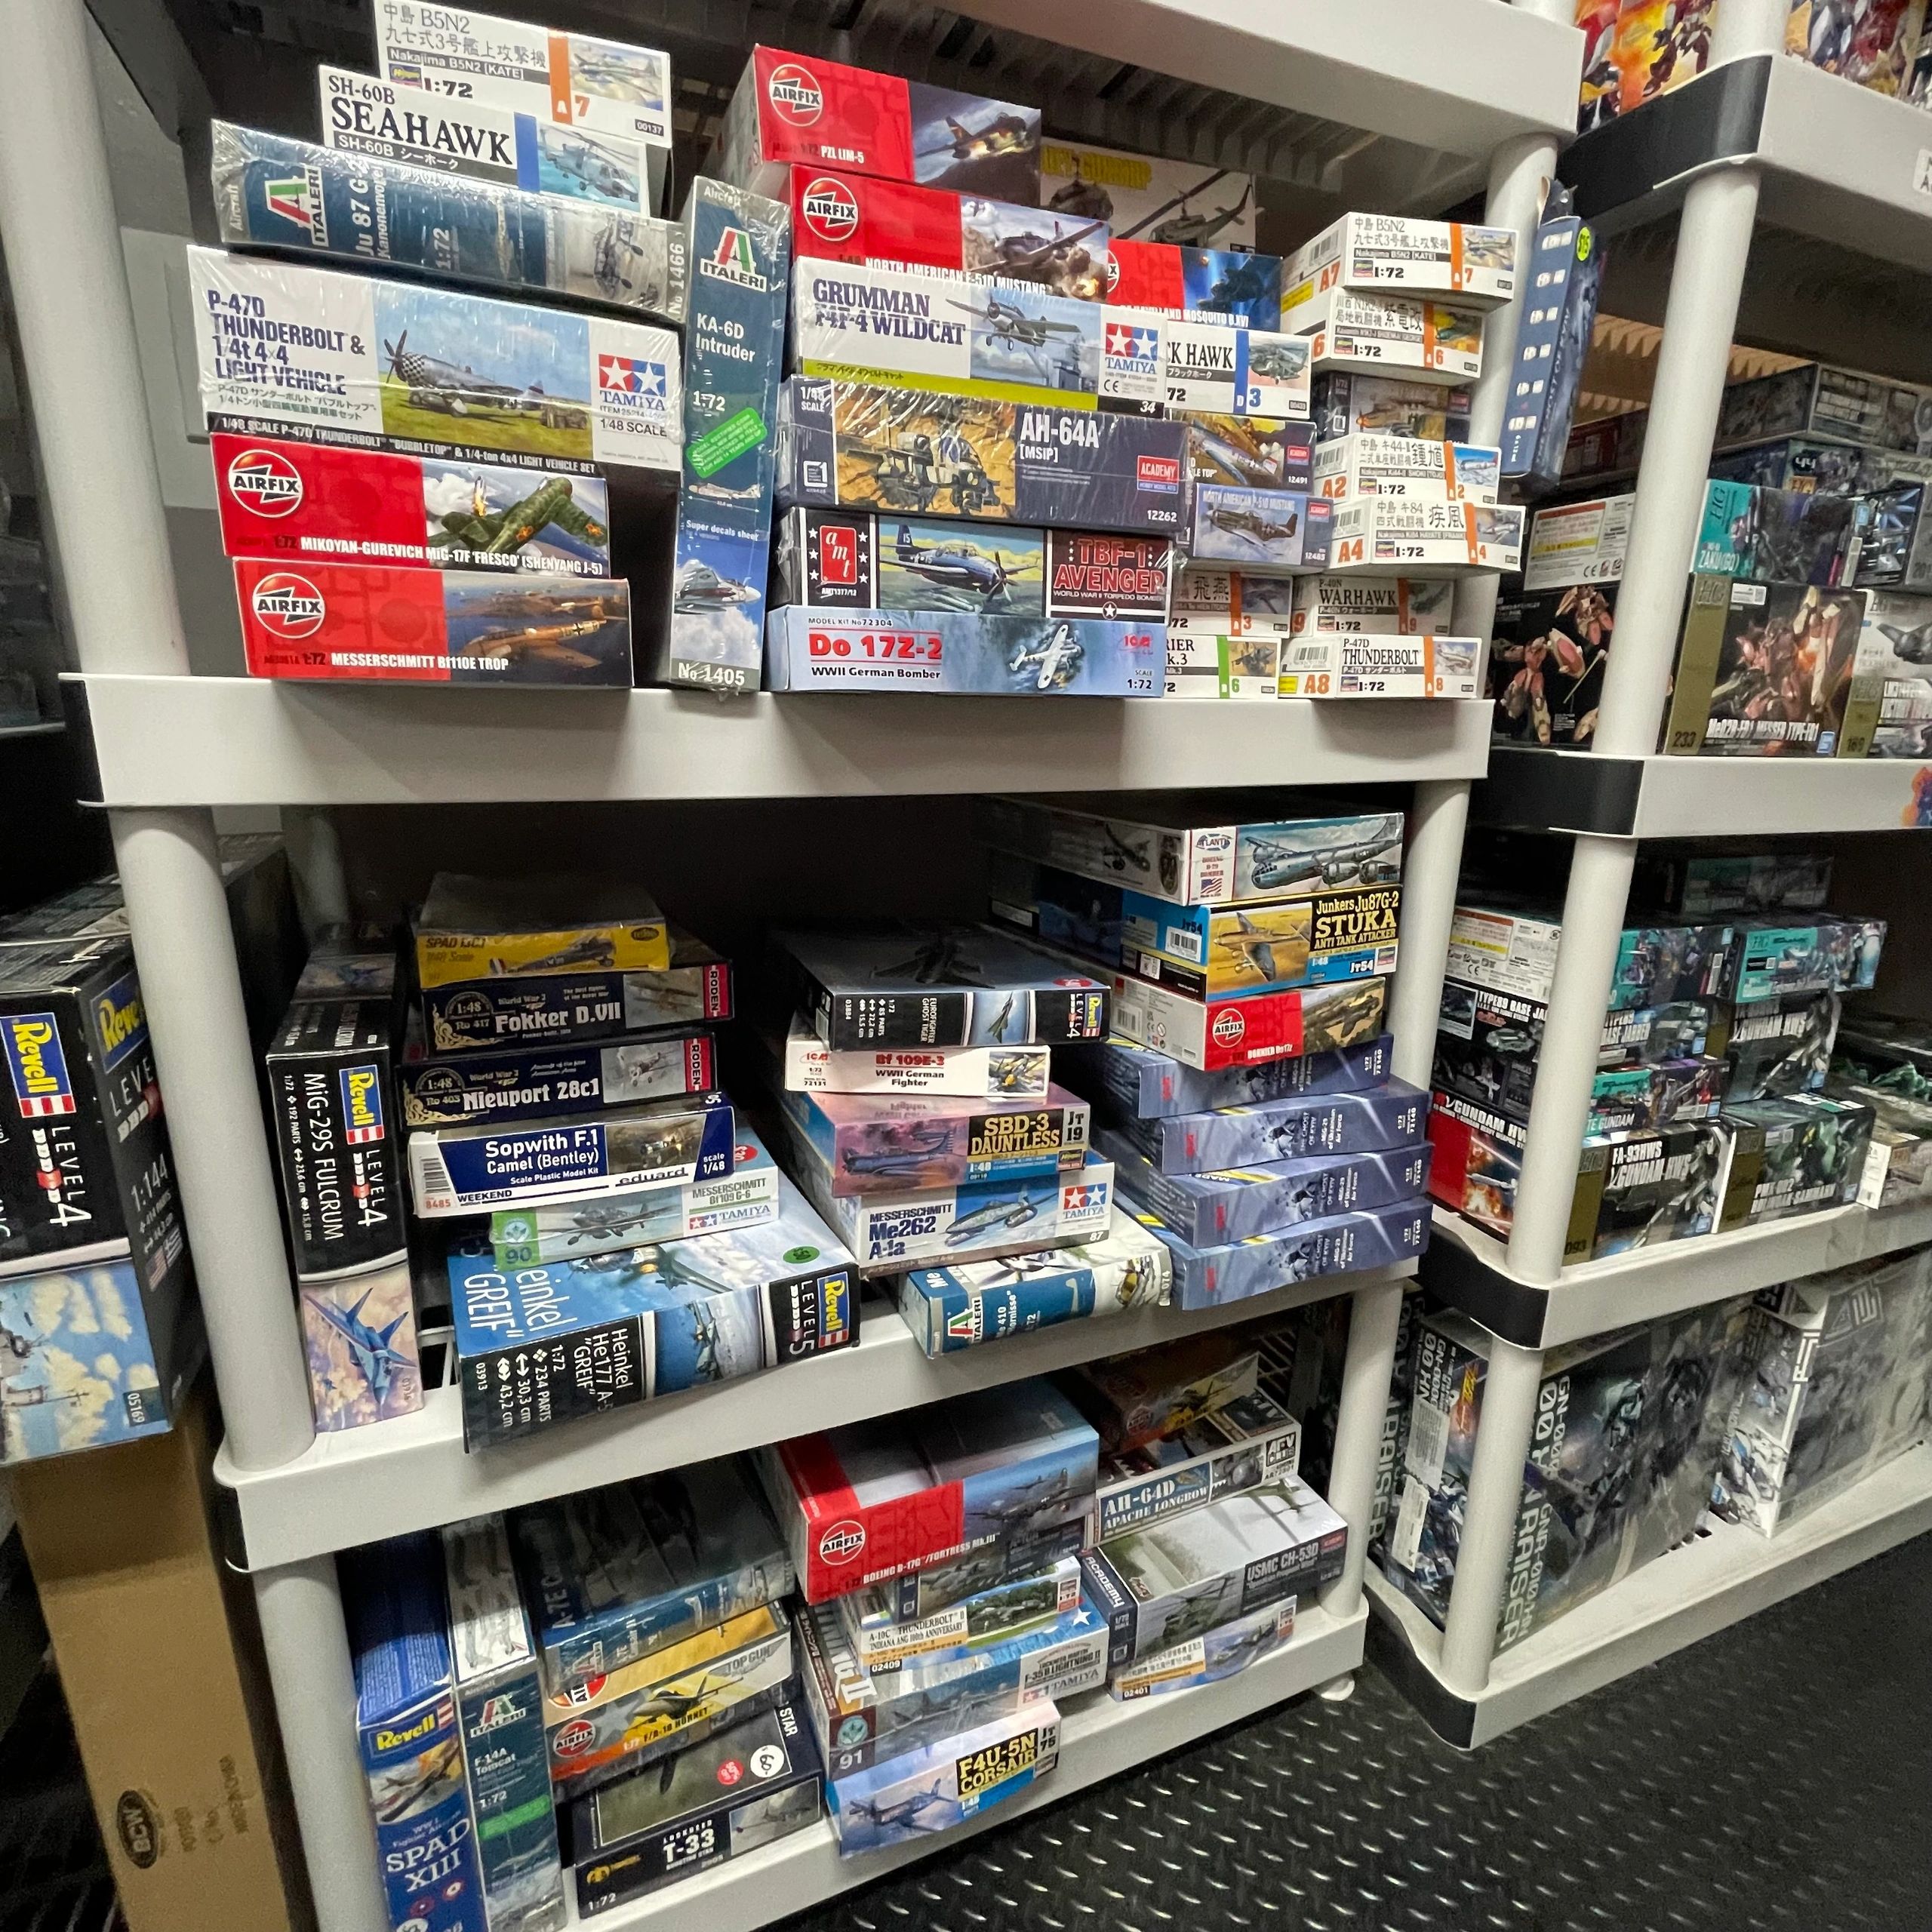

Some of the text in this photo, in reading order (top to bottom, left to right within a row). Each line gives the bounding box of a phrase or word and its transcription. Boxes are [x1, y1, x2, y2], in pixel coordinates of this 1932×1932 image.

[422, 8, 469, 33] B5N2
[390, 48, 525, 80] Nakajima B5N2 [KATE]
[329, 76, 395, 105] SH-60B
[773, 86, 820, 105] AIRFIX
[331, 97, 512, 165] SEAHAWK
[339, 135, 458, 171] SH-60B シーホーク
[821, 146, 864, 164] PZL LIM-5
[806, 204, 857, 219] AIRFIX
[1377, 218, 1404, 232] B5N2
[703, 262, 764, 290] ITALERI
[1374, 267, 1404, 278] 1:72
[1465, 268, 1473, 283] 7
[813, 278, 930, 317] GRUMMAN
[211, 313, 365, 355] THUNDERBOLT &
[697, 312, 743, 340] KA-6D
[696, 334, 755, 363] Intruder
[1186, 343, 1233, 369] HAWK
[1435, 349, 1443, 365] 6
[1106, 358, 1156, 375] TAMIYA
[600, 390, 665, 411] TAMIYA
[801, 401, 825, 412] SCALE
[1249, 388, 1260, 407] 3
[1020, 412, 1099, 448] AH-64A
[233, 473, 300, 493] AIRFIX
[1288, 476, 1308, 485] 12491
[1322, 475, 1346, 498] A2
[1378, 485, 1405, 494] 1:72
[1147, 510, 1177, 522] 12262
[1077, 539, 1146, 568] TBF-1
[1338, 540, 1363, 563] A4
[1396, 546, 1424, 557] 1:72
[1479, 545, 1486, 558] 4
[1054, 565, 1164, 594] AVENGER
[1320, 589, 1396, 604] WARHAWK
[1697, 583, 1725, 601] HG
[257, 598, 322, 614] AIRFIX
[1336, 621, 1361, 631] 1:72
[809, 633, 943, 660] Do 17Z-2
[1343, 638, 1369, 648] P-47D
[303, 653, 326, 666] 1:72
[331, 652, 435, 669] MESSERSCHMITT
[438, 655, 475, 669] Bf110E
[478, 657, 509, 671] TROP
[1343, 649, 1418, 665] THUNDERBOLT
[811, 666, 940, 679] WWII German Bomber
[1128, 679, 1152, 690] 1:72
[1304, 675, 1329, 694] A8
[1358, 682, 1385, 691] 1:72
[1436, 678, 1443, 691] 8
[1673, 731, 1696, 748] 233
[1316, 891, 1398, 915] Junkers Ju87G-2
[1315, 909, 1396, 938] STUKA
[1315, 929, 1395, 949] ANTI TANK ATTACKER
[496, 1002, 621, 1033] Fokker D.VII
[1088, 995, 1100, 1028] Revell
[1510, 998, 1531, 1017] BASE
[928, 998, 937, 1043] EUROFIGHTER
[1215, 1023, 1243, 1034] AIRFIX
[13, 1021, 59, 1095] Revell
[692, 1044, 700, 1084] RODEN
[875, 1054, 944, 1066] Bf 109E-3
[348, 1072, 375, 1125] Revell
[463, 1078, 599, 1111] Nieuport 28c1
[984, 1112, 1049, 1136] SBD-3
[1598, 1114, 1635, 1130] GUNDAM
[486, 1129, 598, 1158] Sopwith F.1
[971, 1129, 1060, 1156] DAUNTLESS
[303, 1073, 344, 1241] MiG-29S FULCRUM
[487, 1149, 599, 1174] Camel (Bentley)
[703, 1153, 724, 1163] scale
[968, 1161, 992, 1172] 1:48
[534, 1174, 561, 1183] Plastic
[563, 1170, 584, 1178] Model
[619, 1167, 685, 1185] eduard
[458, 1189, 512, 1202] WEEKEND
[693, 1177, 766, 1198] MESSERSCHMITT
[426, 1198, 451, 1209] 8485
[719, 1205, 770, 1221] TAMIYA
[869, 1204, 952, 1223] MESSERSCHMITT
[1063, 1208, 1104, 1219] TAMIYA
[869, 1216, 936, 1241] Me262
[1089, 1231, 1104, 1241] 87
[824, 1280, 844, 1332] Revell
[611, 1328, 633, 1388] Heinkel
[476, 1363, 488, 1390] 03913
[518, 1379, 531, 1423] 30,3 cm
[535, 1366, 551, 1422] 234 PARTS
[500, 1385, 513, 1427] 43,2 cm
[1106, 1481, 1175, 1516] AH-64D
[1106, 1486, 1208, 1530] APACHE LONGBOW
[823, 1534, 863, 1552] AIRFIX
[1247, 1557, 1278, 1581] USMC
[1281, 1542, 1318, 1568] CH-53D
[1085, 1556, 1125, 1607] ACADEMY
[1500, 1509, 1538, 1646] RAISER
[870, 1638, 894, 1650] INDIANA
[896, 1636, 909, 1645] ANG
[924, 1624, 963, 1639] ANNIVERSARY
[871, 1661, 901, 1672] 02409
[1124, 1686, 1149, 1697] 02401
[377, 1715, 435, 1751] Revell
[555, 1729, 593, 1750] AIRFIX
[475, 1754, 516, 1776] Tomcat
[959, 1732, 1035, 1779] F4U-5N
[960, 1752, 1035, 1794] CORSAIR
[386, 1818, 470, 1873] SPAD
[663, 1828, 715, 1863] T-33
[405, 1850, 461, 1892] XIII
